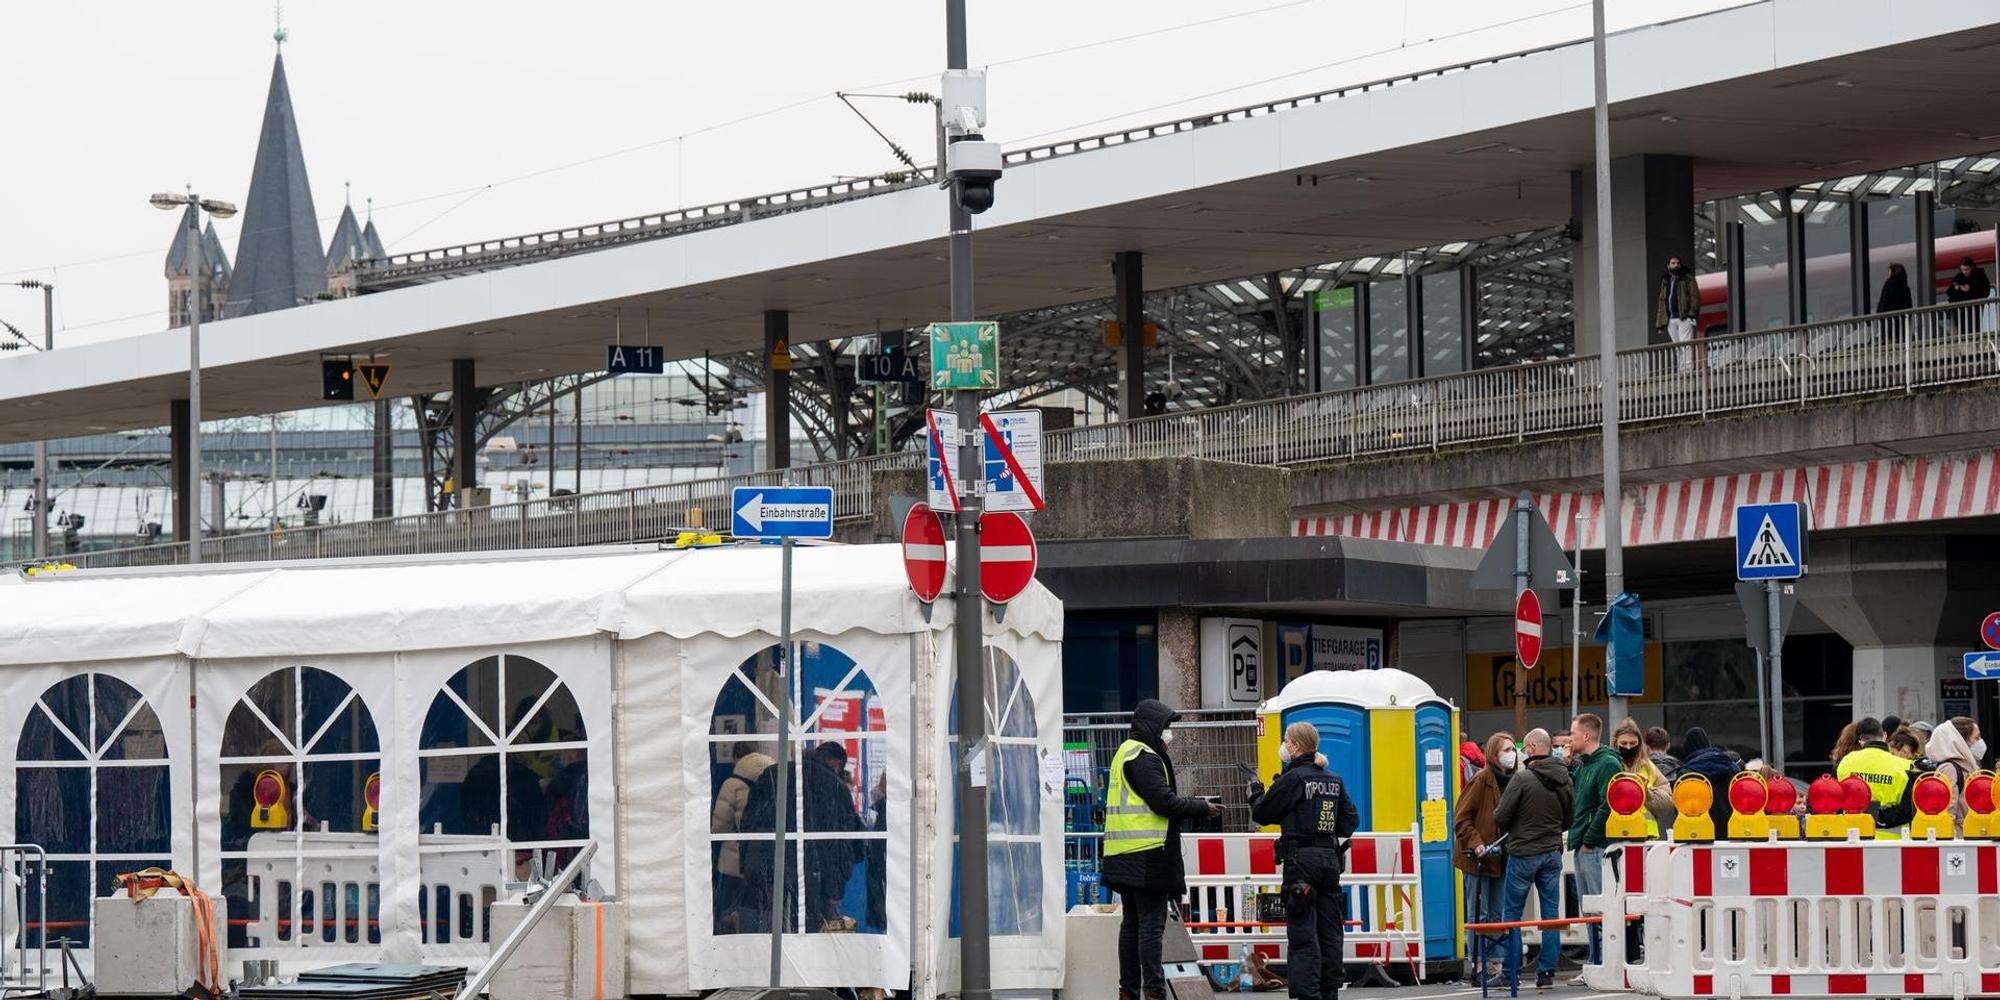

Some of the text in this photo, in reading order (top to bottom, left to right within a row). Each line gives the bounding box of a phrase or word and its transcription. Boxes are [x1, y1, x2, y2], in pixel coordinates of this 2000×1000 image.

[611, 349, 653, 368] A 11
[871, 356, 915, 377] 10 A
[760, 507, 827, 518] Einbahnstraße
[1313, 637, 1365, 656] TIEFGARAGE
[1233, 653, 1245, 690] P
[1322, 801, 1334, 811] BP
[1320, 811, 1335, 821] STA
[1318, 821, 1335, 832] 3212
